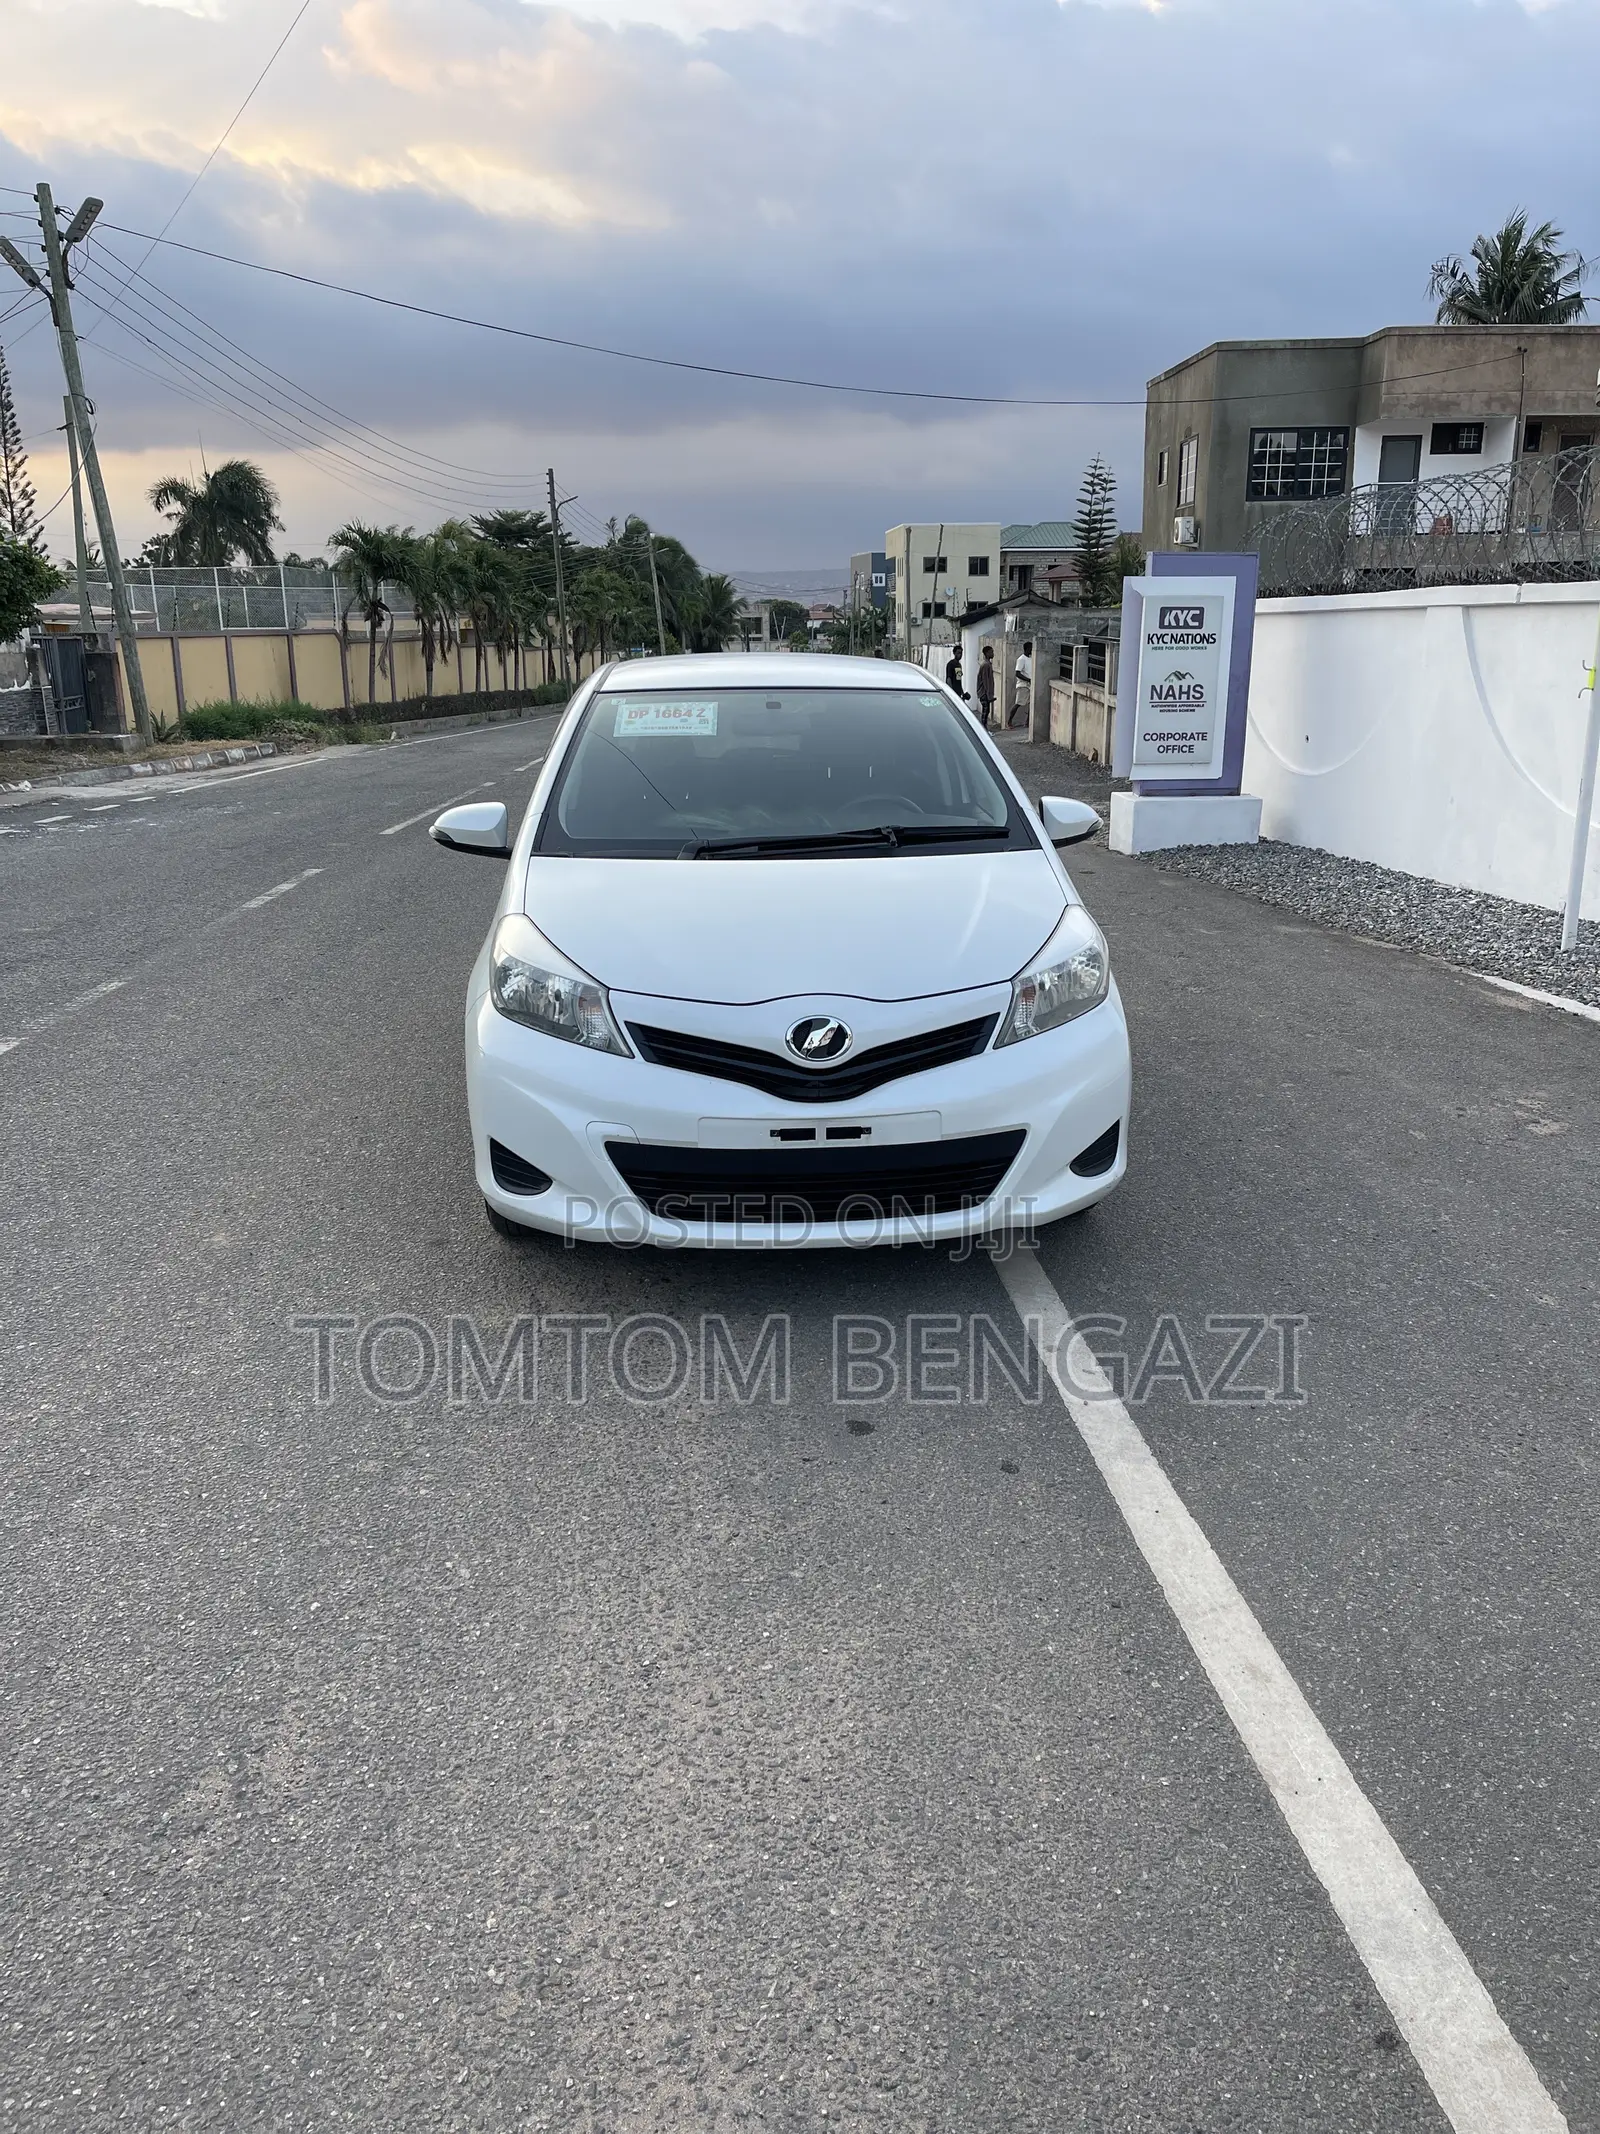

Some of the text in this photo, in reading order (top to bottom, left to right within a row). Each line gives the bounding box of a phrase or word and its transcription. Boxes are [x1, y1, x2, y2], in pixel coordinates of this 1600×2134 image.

[1164, 610, 1200, 626] KYC
[1150, 684, 1204, 701] NAHS
[627, 709, 649, 719] DP
[654, 708, 693, 719] 1664
[1143, 732, 1208, 742] CORPORATE
[1157, 744, 1195, 754] OFFICE
